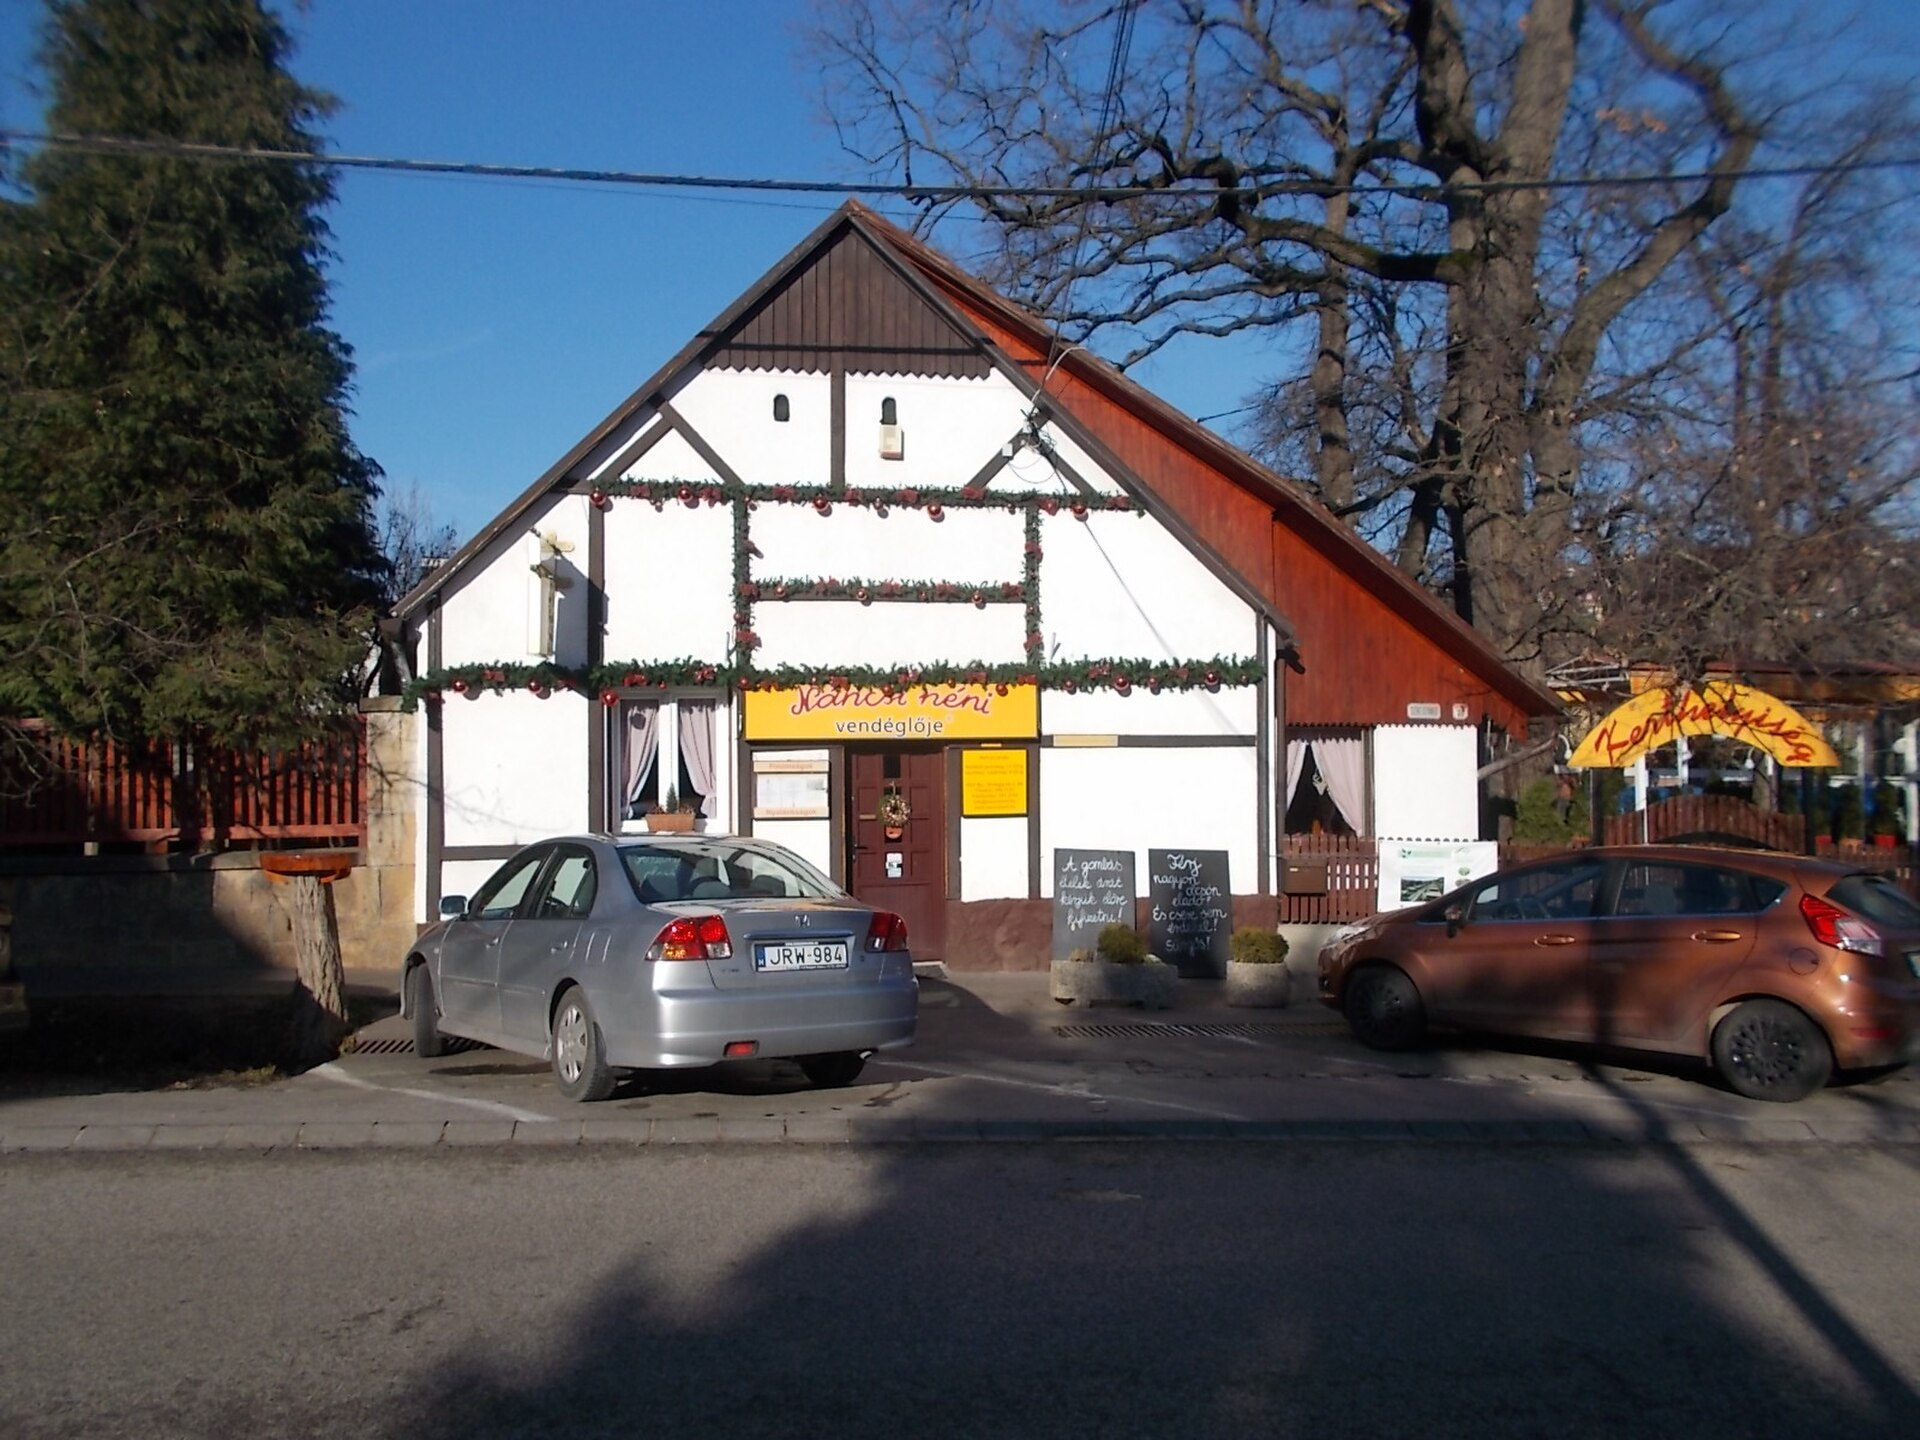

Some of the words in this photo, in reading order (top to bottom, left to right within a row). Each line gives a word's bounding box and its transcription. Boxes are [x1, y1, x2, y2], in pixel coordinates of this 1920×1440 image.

[919, 686, 990, 714] néni
[836, 717, 943, 737] vendéglője
[1062, 855, 1077, 872] A
[1153, 874, 1200, 890] nagyon
[1152, 903, 1167, 921] És
[770, 945, 842, 966] JRW-984
